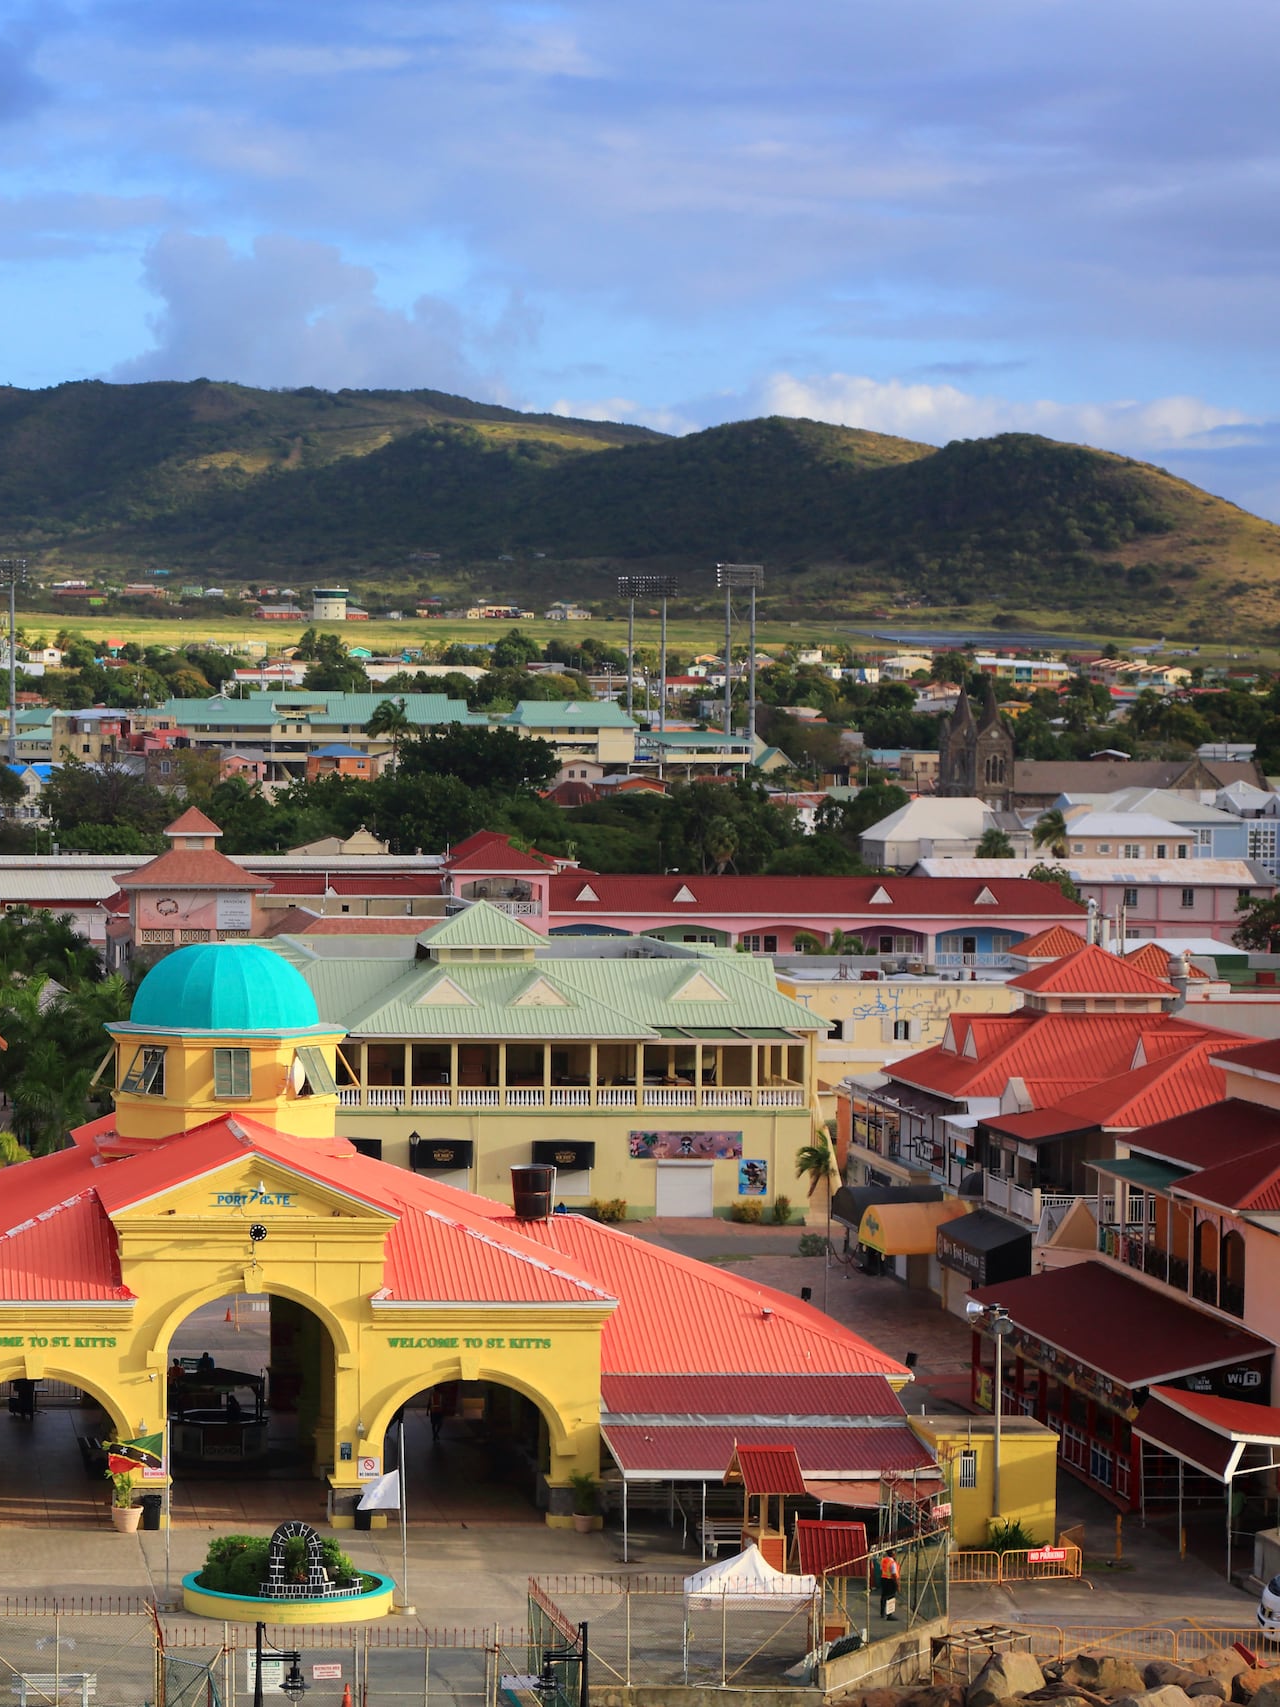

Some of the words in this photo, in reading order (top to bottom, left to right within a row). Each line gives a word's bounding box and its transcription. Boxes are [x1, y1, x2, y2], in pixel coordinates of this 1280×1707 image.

[217, 1194, 248, 1205] PORT
[28, 1336, 48, 1348] TO
[74, 1336, 117, 1349] KITTS
[387, 1337, 459, 1349] WELCOME
[463, 1337, 483, 1349] TO
[509, 1338, 551, 1350] KITTS
[1031, 1552, 1039, 1560] NO
[1040, 1551, 1064, 1560] PARKING
